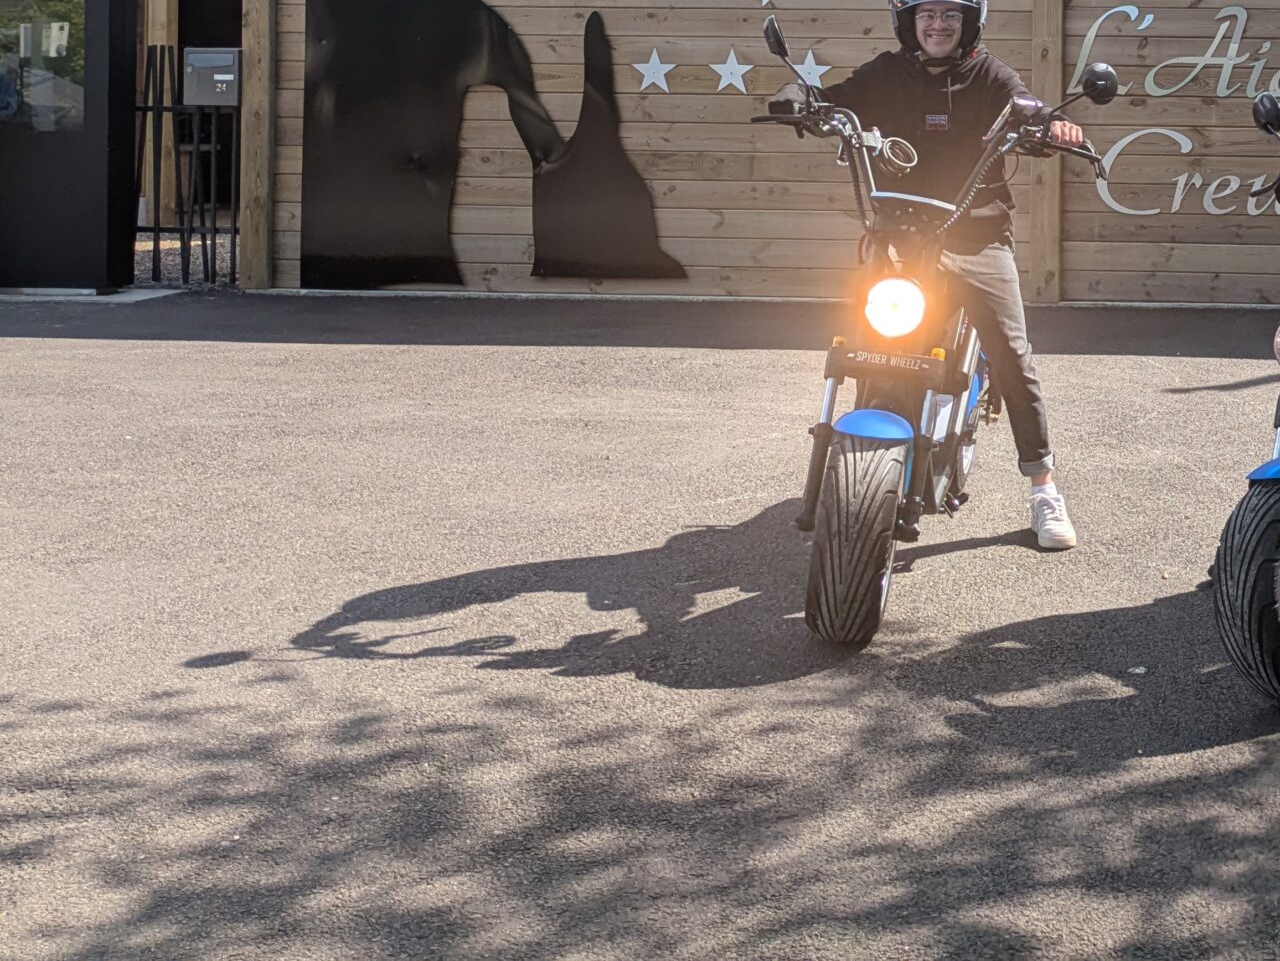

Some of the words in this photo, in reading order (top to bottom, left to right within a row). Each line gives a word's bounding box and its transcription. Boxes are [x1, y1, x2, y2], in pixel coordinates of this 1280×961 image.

[215, 83, 227, 92] 24
[856, 351, 888, 365] SPYDER
[890, 355, 921, 370] WHEELZ
